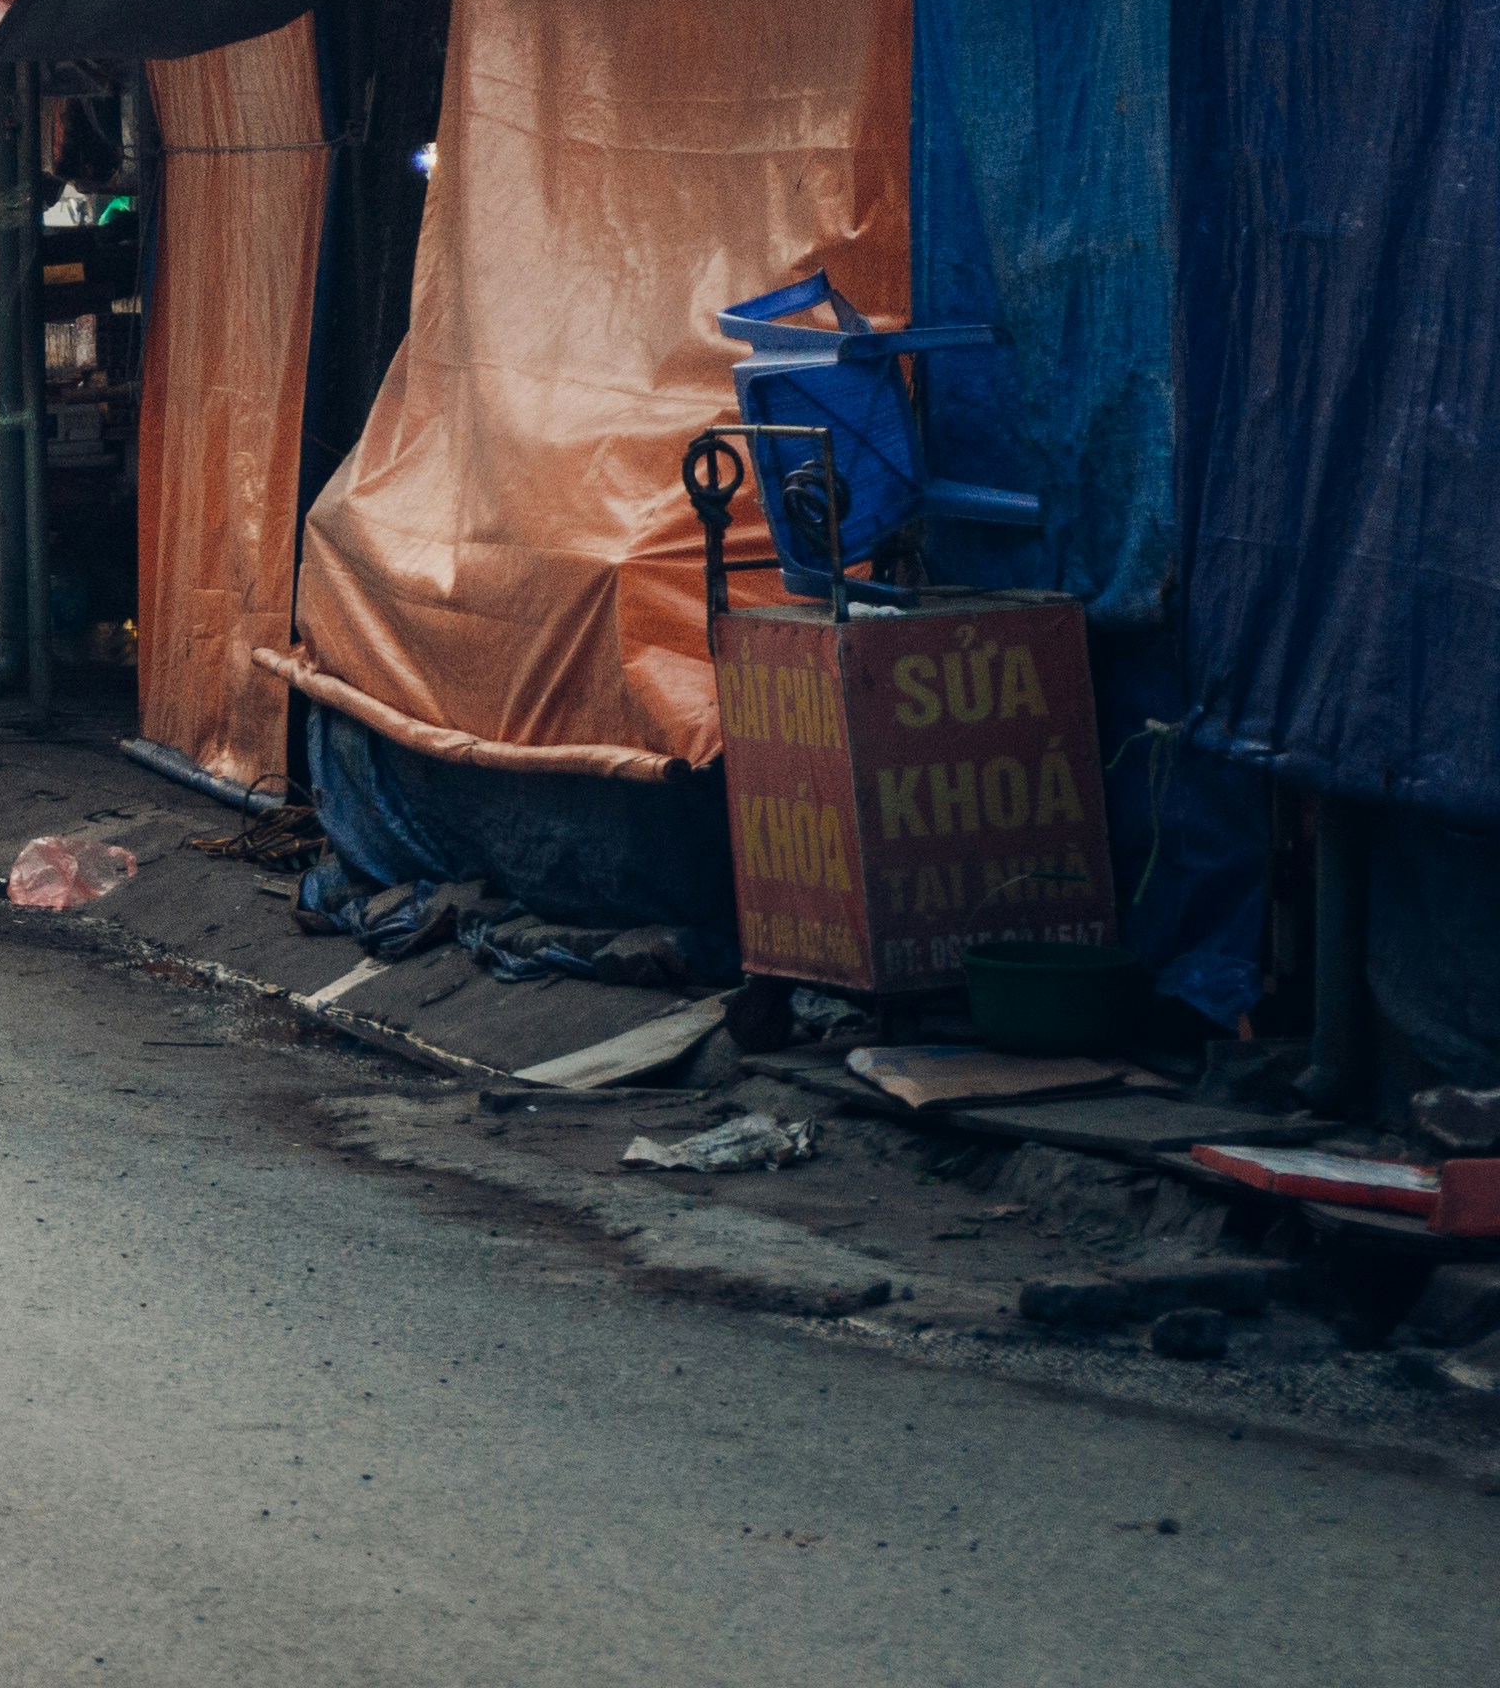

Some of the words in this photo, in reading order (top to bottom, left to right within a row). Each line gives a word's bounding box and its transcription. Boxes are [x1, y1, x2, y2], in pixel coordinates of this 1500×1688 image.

[721, 636, 770, 742] CẮT
[776, 653, 842, 749] CHÌA
[894, 625, 1049, 728] SỬA
[739, 782, 852, 893] KHÓA
[876, 735, 1086, 840] KHOÁ
[880, 859, 966, 922] TẠI
[985, 843, 1097, 907] NHÀ
